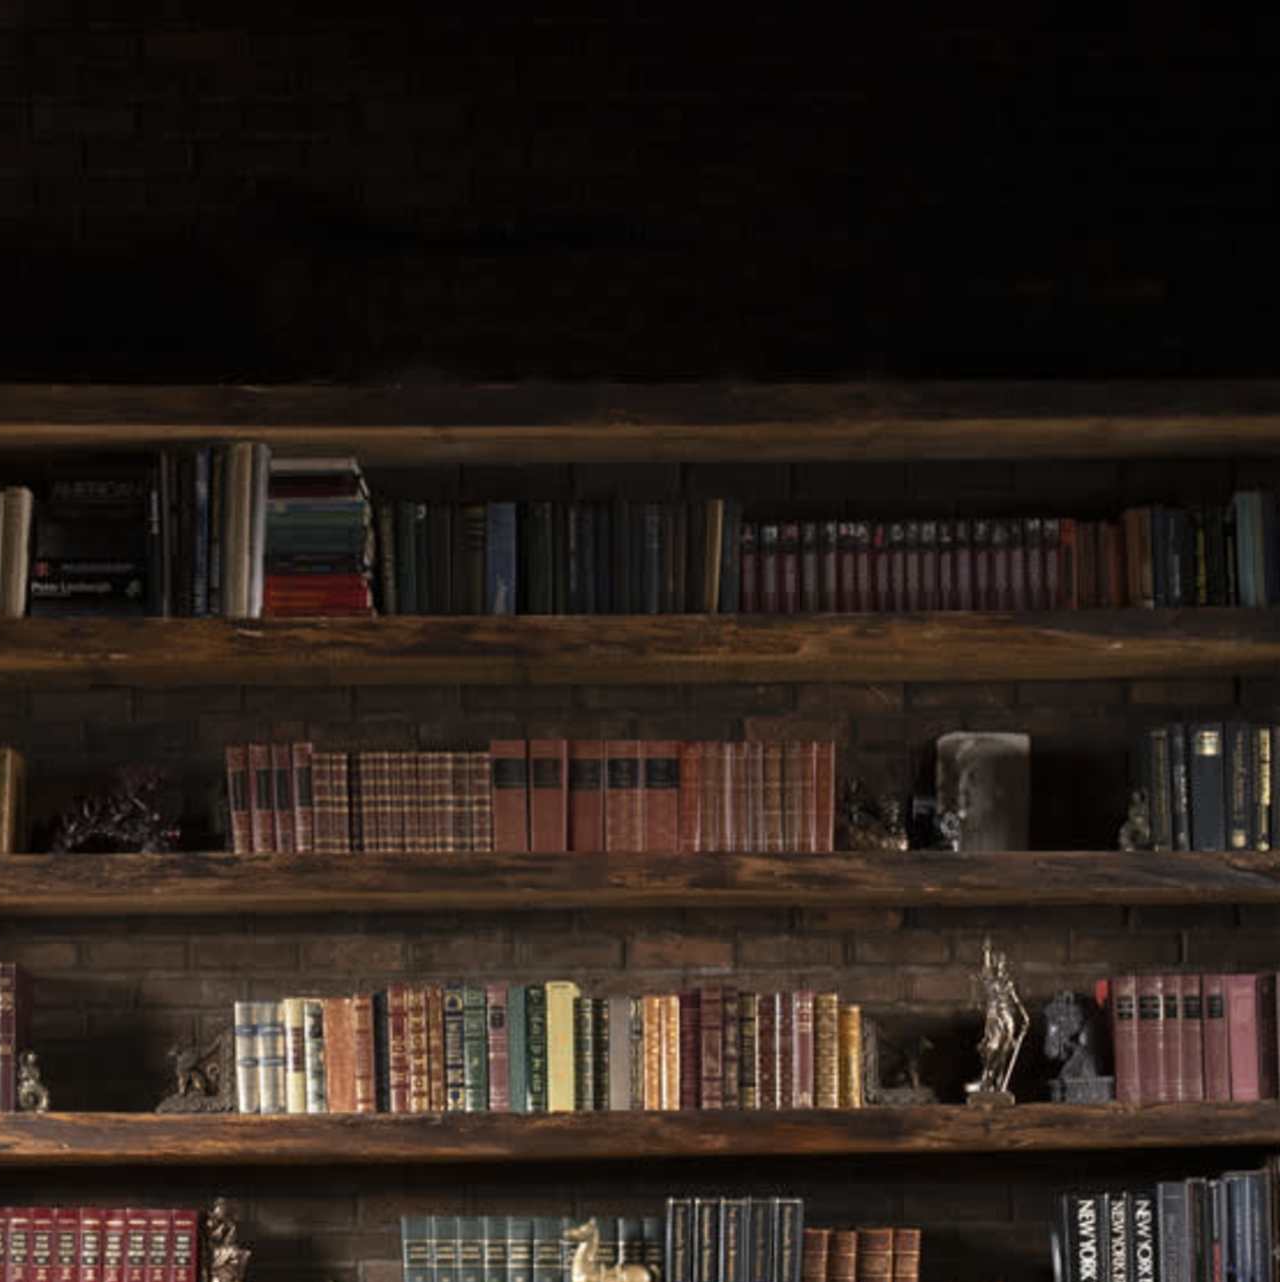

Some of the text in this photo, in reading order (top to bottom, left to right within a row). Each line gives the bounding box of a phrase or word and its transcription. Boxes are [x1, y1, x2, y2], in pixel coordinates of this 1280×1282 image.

[1077, 1199, 1095, 1238] NEW
[1111, 1200, 1125, 1235] NEW
[1135, 1198, 1152, 1238] NEW
[1079, 1239, 1097, 1281] YORK
[1111, 1235, 1126, 1273] YORK
[1136, 1239, 1153, 1277] YORK
